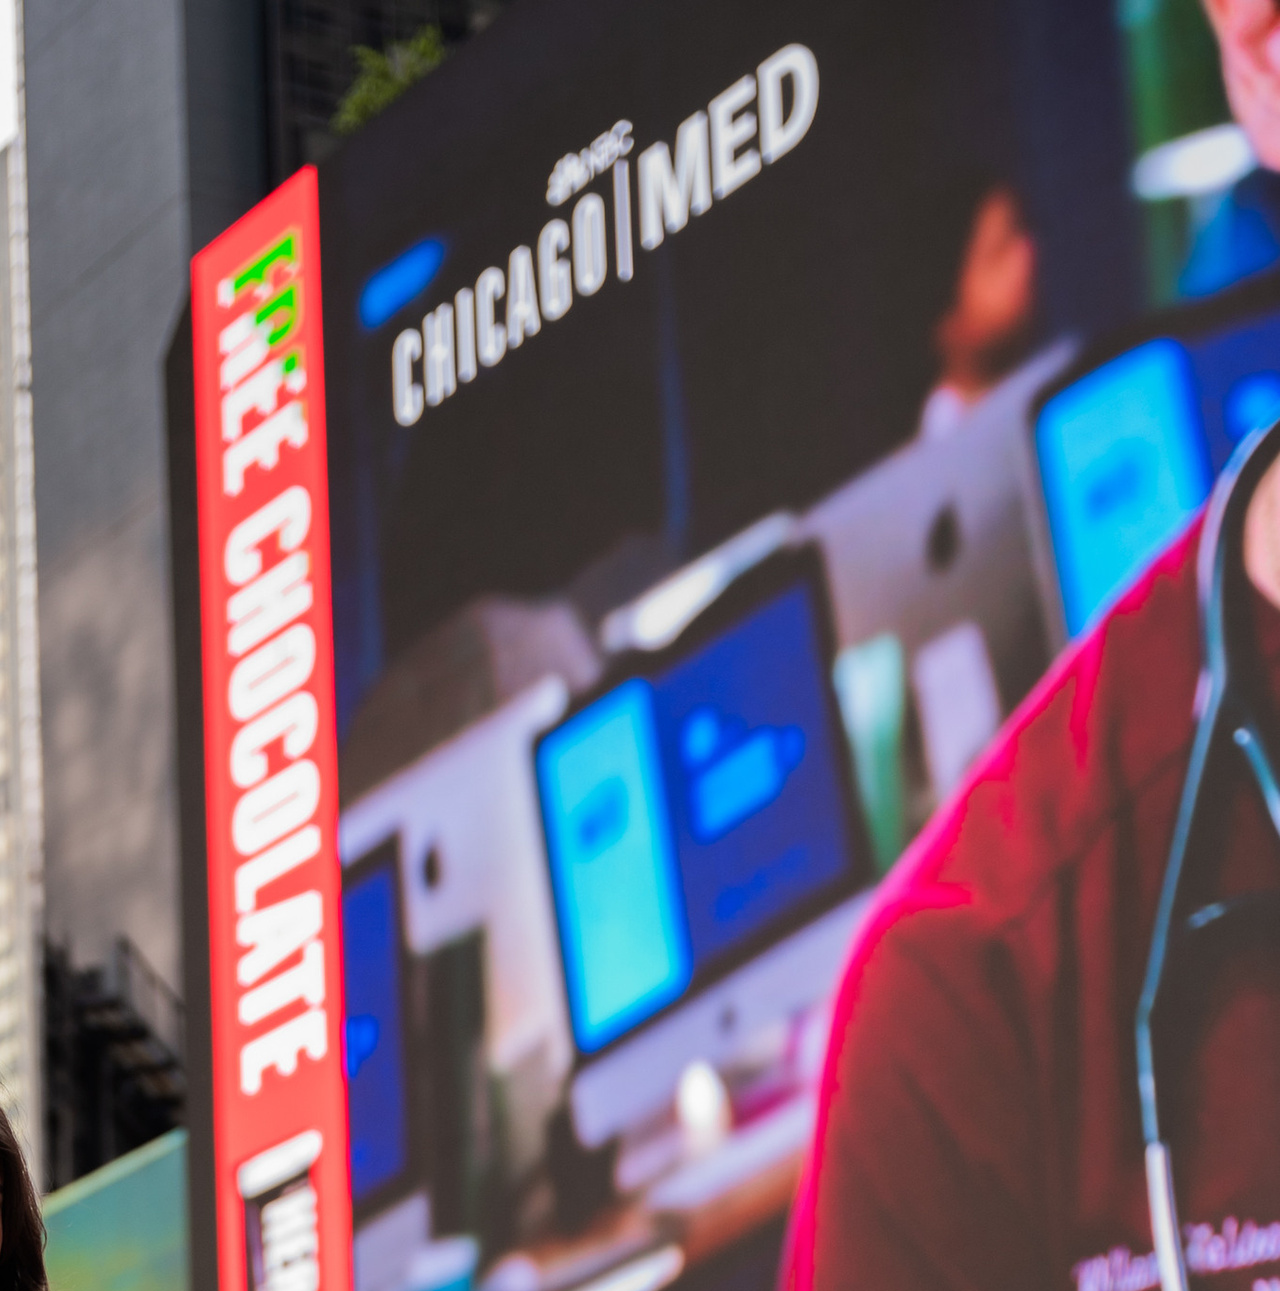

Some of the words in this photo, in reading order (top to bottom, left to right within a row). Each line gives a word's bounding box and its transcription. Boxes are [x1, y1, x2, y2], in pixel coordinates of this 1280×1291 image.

[217, 230, 308, 497] FREE
[392, 192, 607, 427] CHICAGO
[638, 42, 820, 251] MED
[225, 486, 327, 1096] CHOCOLATE
